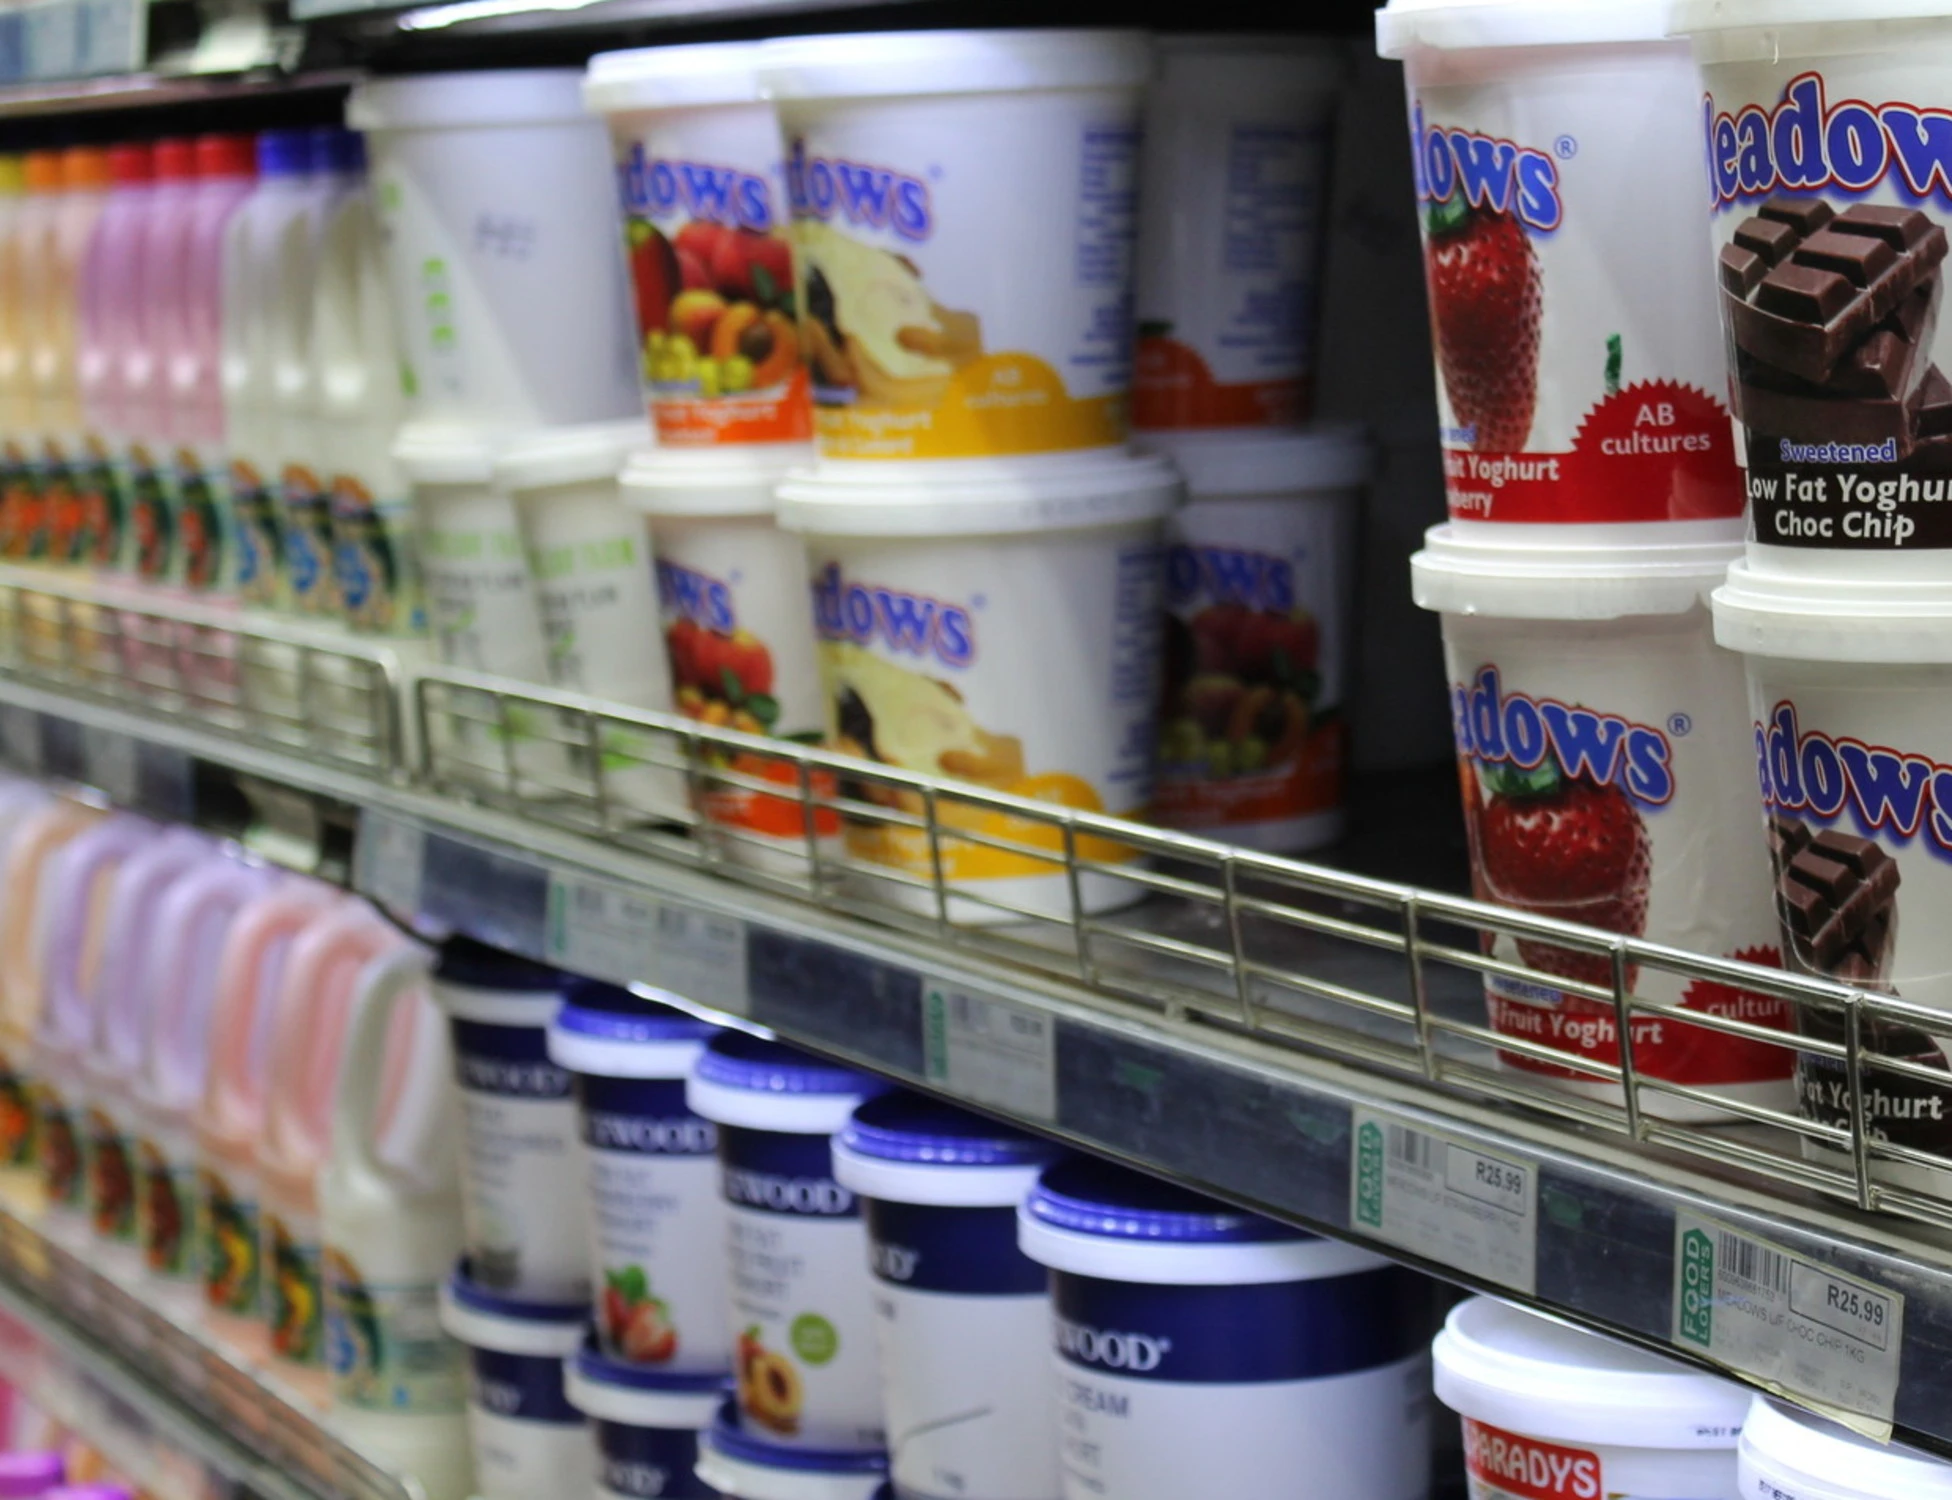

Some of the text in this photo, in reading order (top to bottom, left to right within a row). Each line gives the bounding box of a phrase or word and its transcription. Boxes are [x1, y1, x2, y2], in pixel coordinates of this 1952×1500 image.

[1703, 71, 1952, 212] eadow
[1634, 403, 1675, 427] AB
[1600, 431, 1711, 456] cultures
[1780, 437, 1898, 463] Sweetened
[1467, 455, 1560, 488] Yoghurt
[1785, 473, 1827, 502] Fat
[1836, 474, 1952, 511] Yoghu
[1775, 509, 1915, 545] Choc Chip
[1549, 1014, 1663, 1048] Yoghrt
[1475, 1160, 1522, 1195] R25.99
[1683, 1236, 1699, 1336] FOOD
[1697, 1245, 1712, 1341] LOVER'S
[1827, 1283, 1884, 1326] R25.99
